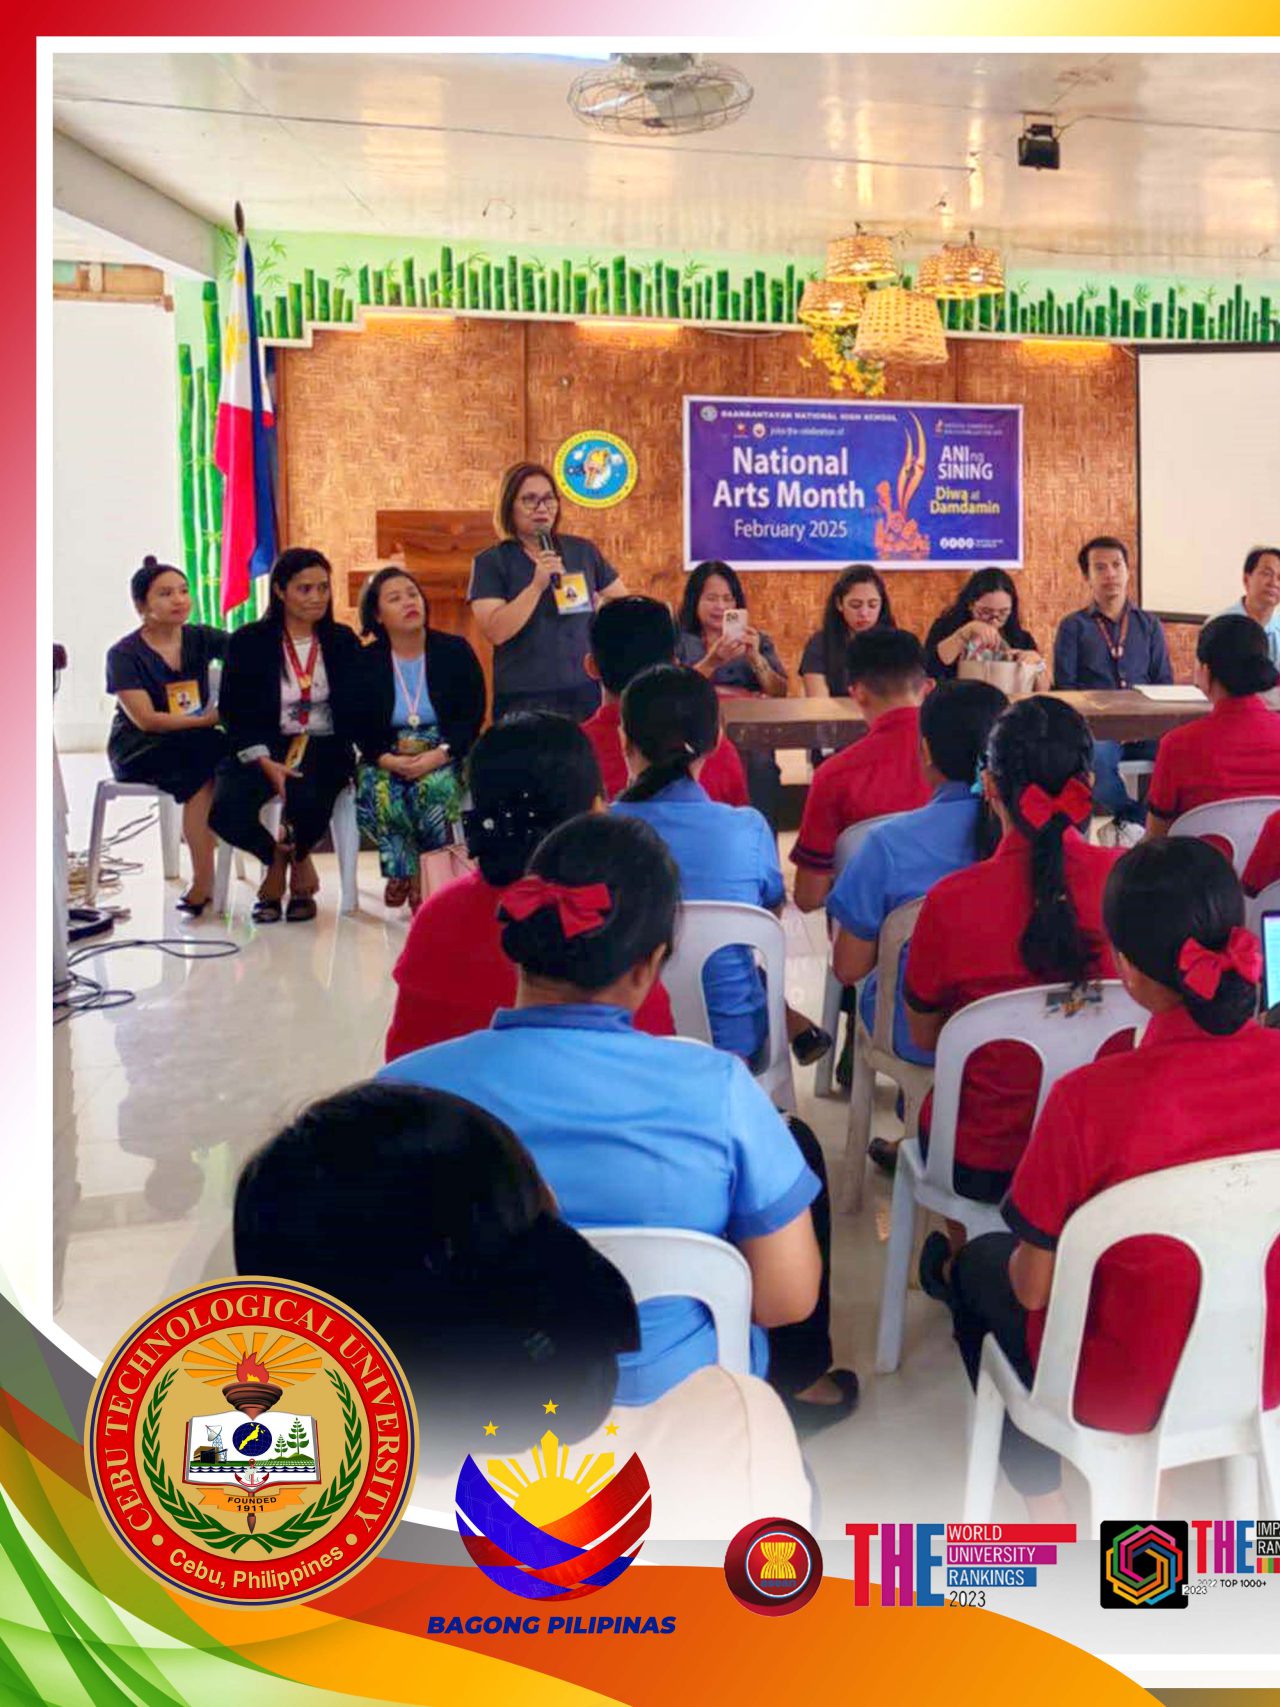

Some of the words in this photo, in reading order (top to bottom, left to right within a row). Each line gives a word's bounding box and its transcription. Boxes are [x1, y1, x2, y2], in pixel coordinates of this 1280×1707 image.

[794, 411, 838, 420] NATIONAL
[863, 413, 898, 422] SCHOOL
[733, 446, 848, 475] National
[941, 445, 969, 462] ANI
[970, 452, 985, 465] ng
[938, 462, 993, 480] SINING
[713, 480, 770, 508] Arts
[777, 480, 865, 508] Month
[935, 486, 969, 501] Diwa
[930, 500, 1000, 514] Damdamin
[734, 518, 805, 542] February
[809, 520, 848, 538] 2025
